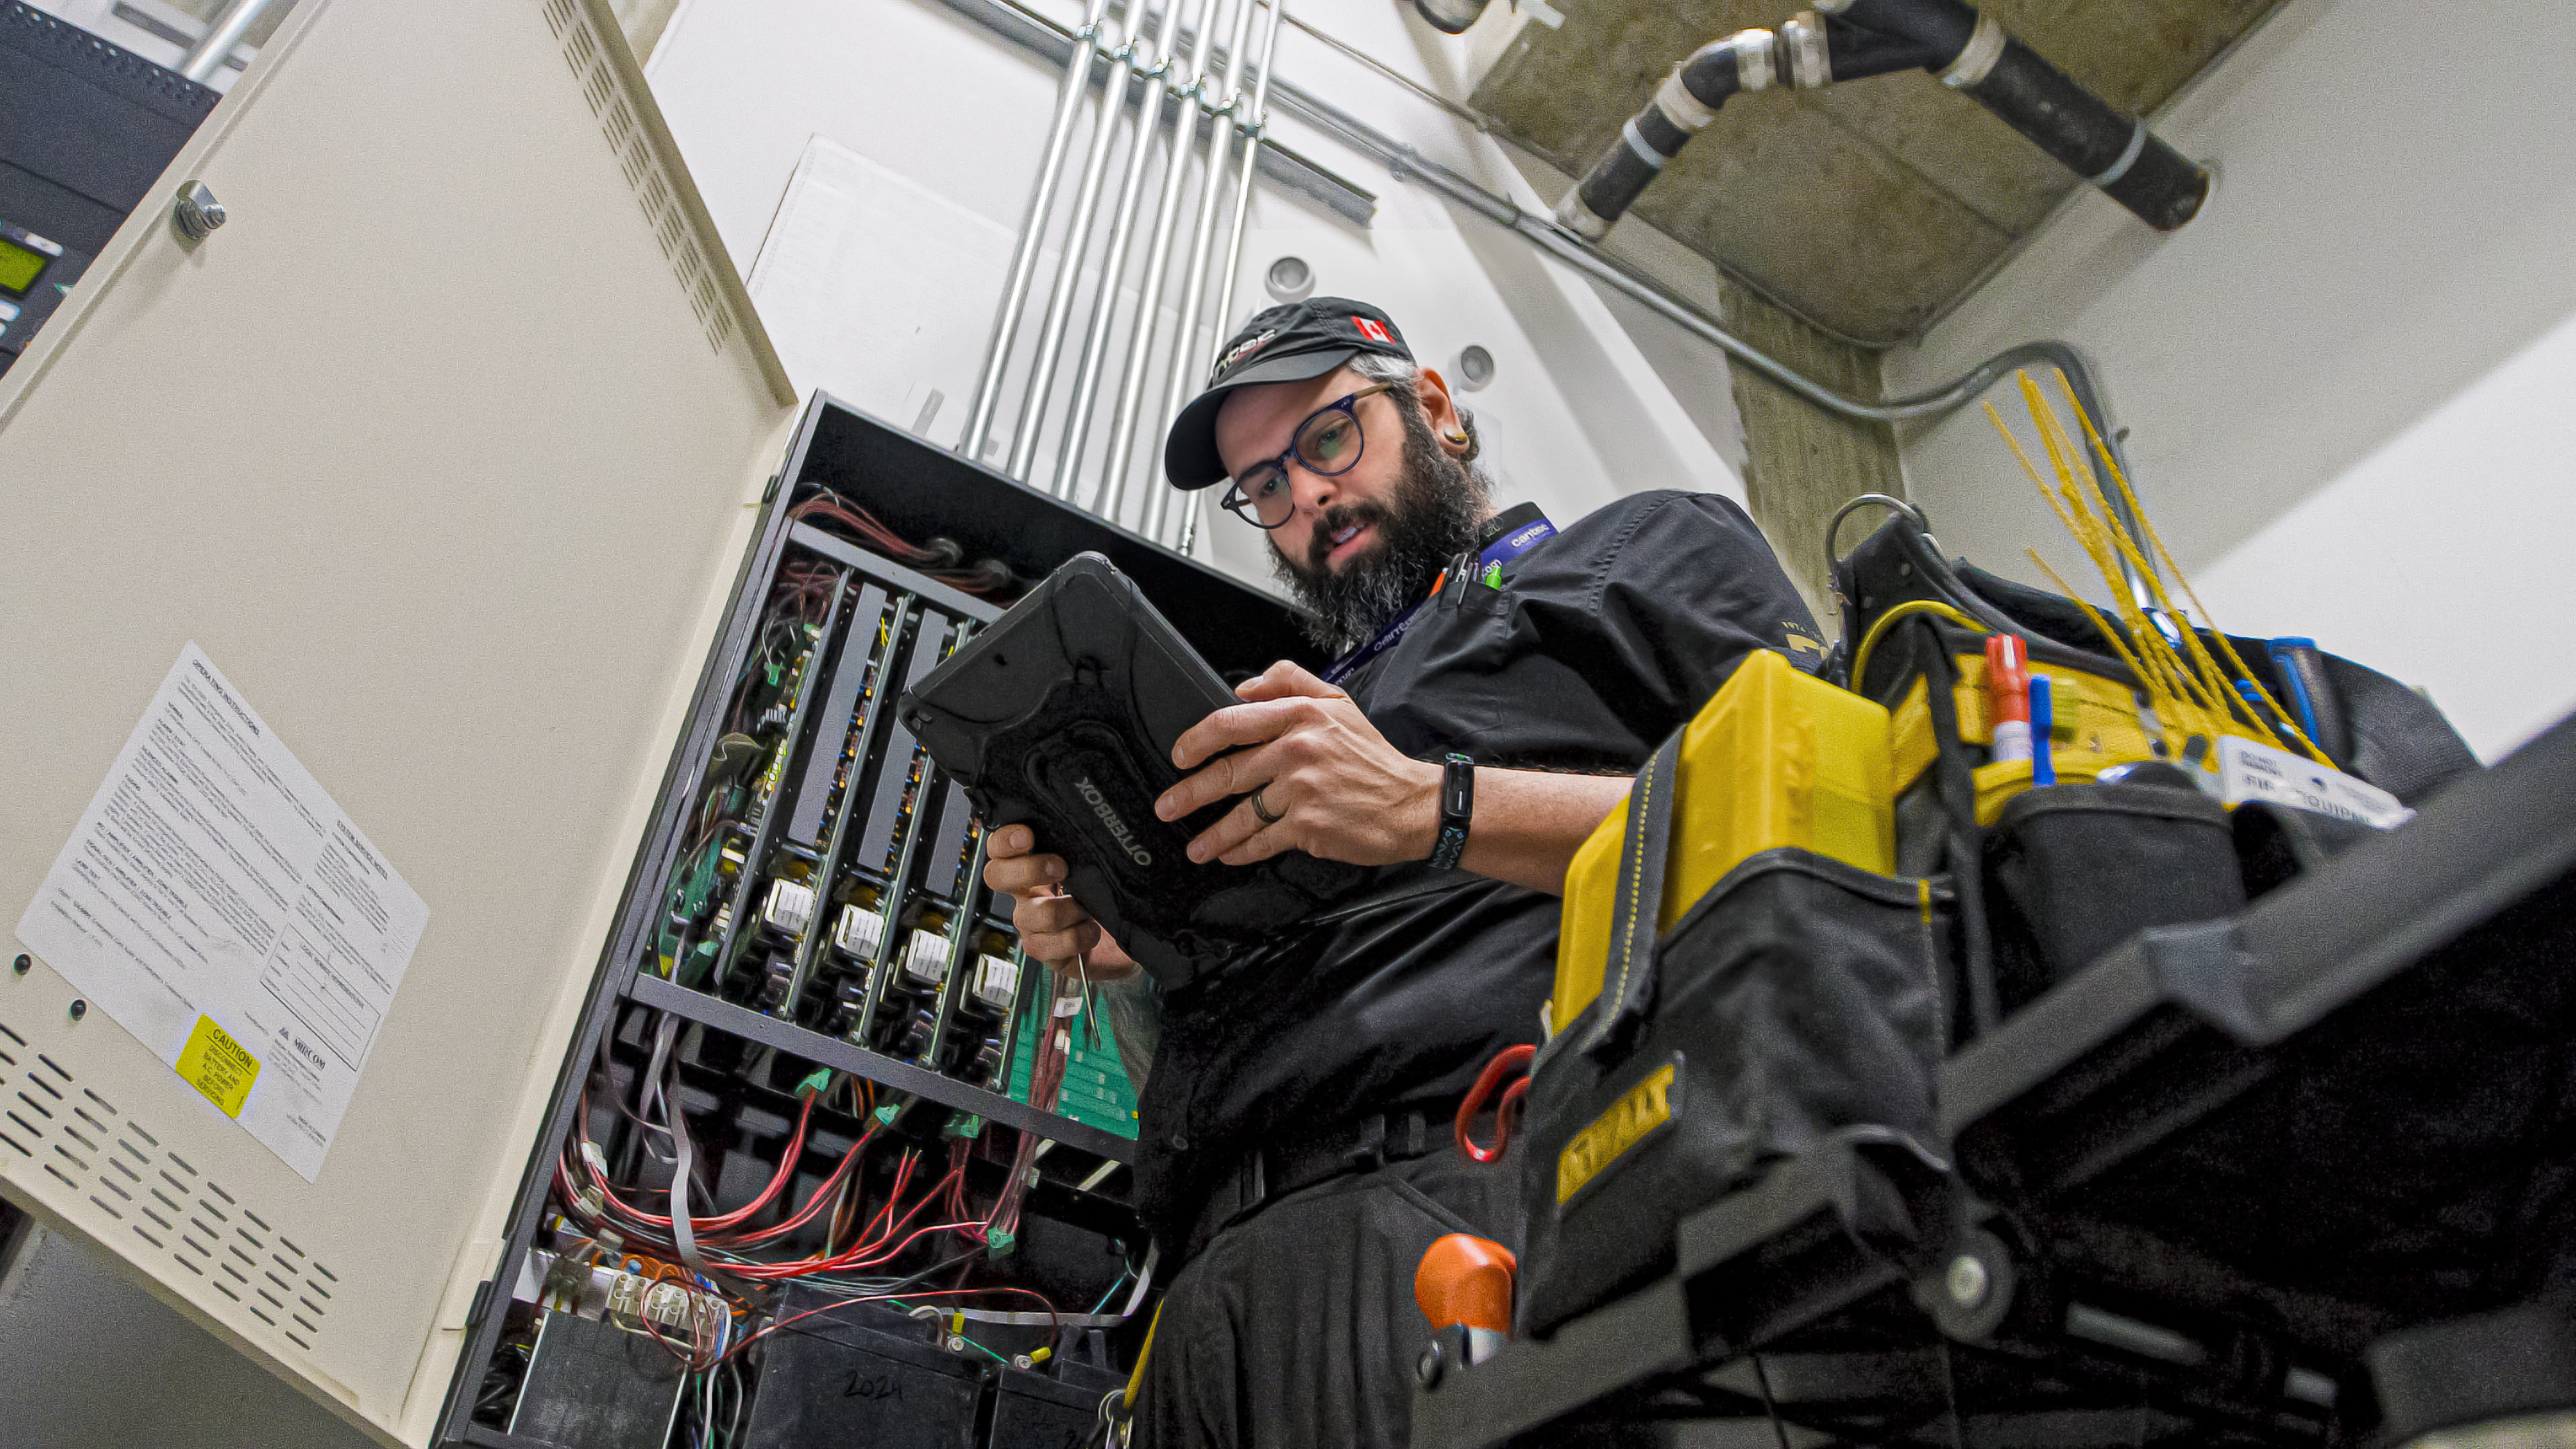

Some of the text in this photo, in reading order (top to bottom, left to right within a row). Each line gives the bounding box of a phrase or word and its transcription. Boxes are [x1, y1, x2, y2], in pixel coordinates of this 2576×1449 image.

[1511, 523, 1550, 547] cantec
[193, 658, 223, 694] OPERATING
[223, 692, 260, 736] INSTRUCTIONS
[1075, 776, 1152, 865] OTTERBOX
[209, 1044, 242, 1076] DISCONNECT
[212, 1028, 252, 1068] CAUTION
[292, 1036, 325, 1071] MIRCOM
[203, 1052, 239, 1086] BATTERY AND
[843, 1369, 902, 1401] 2024
